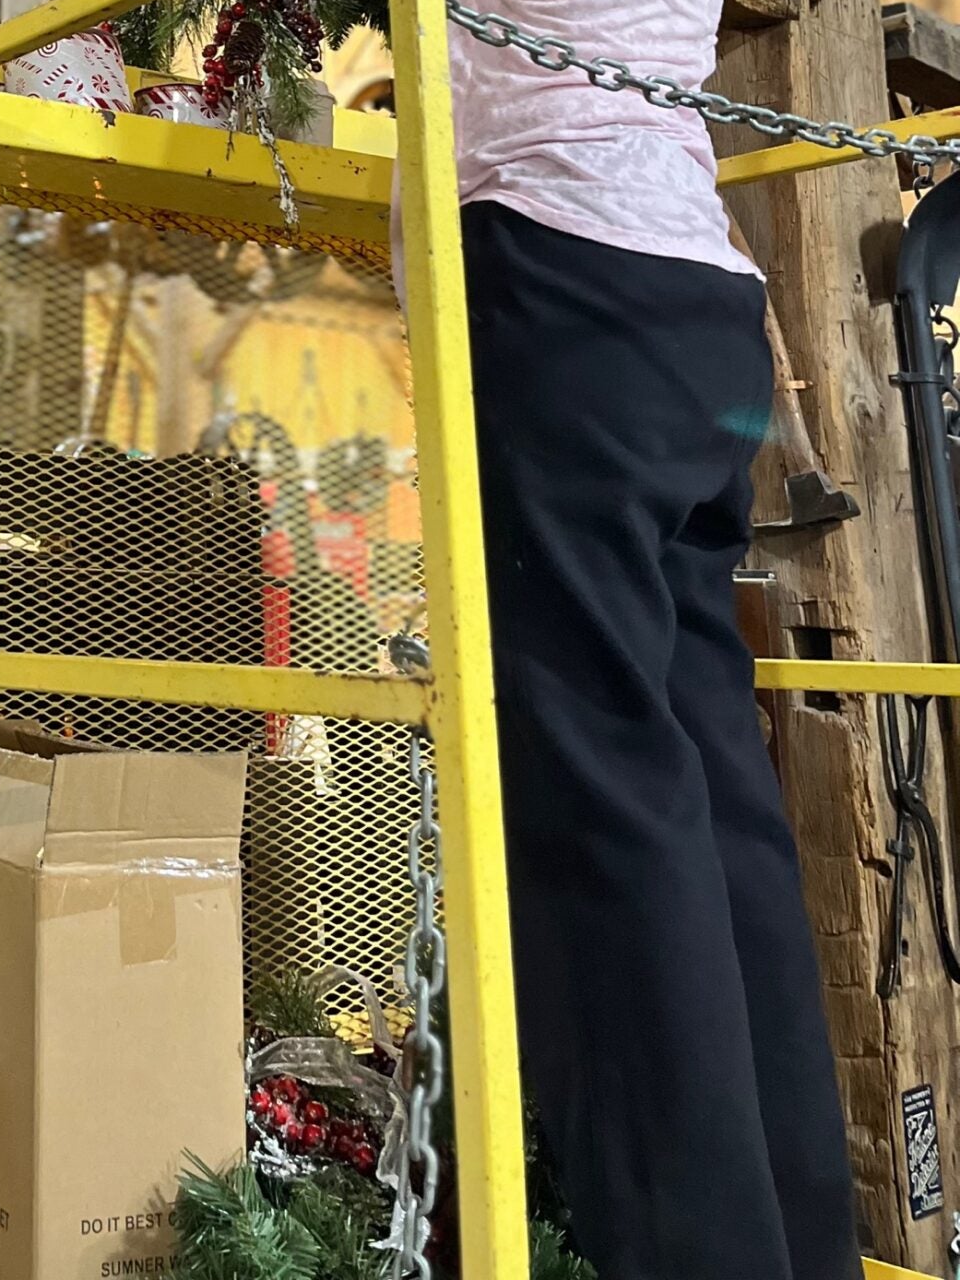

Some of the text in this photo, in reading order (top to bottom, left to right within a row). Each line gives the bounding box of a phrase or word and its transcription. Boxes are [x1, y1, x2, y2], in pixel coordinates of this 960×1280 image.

[81, 1218, 103, 1235] DO
[107, 1216, 120, 1232] IT
[125, 1212, 163, 1231] BEST
[101, 1255, 165, 1277] SUMNER
